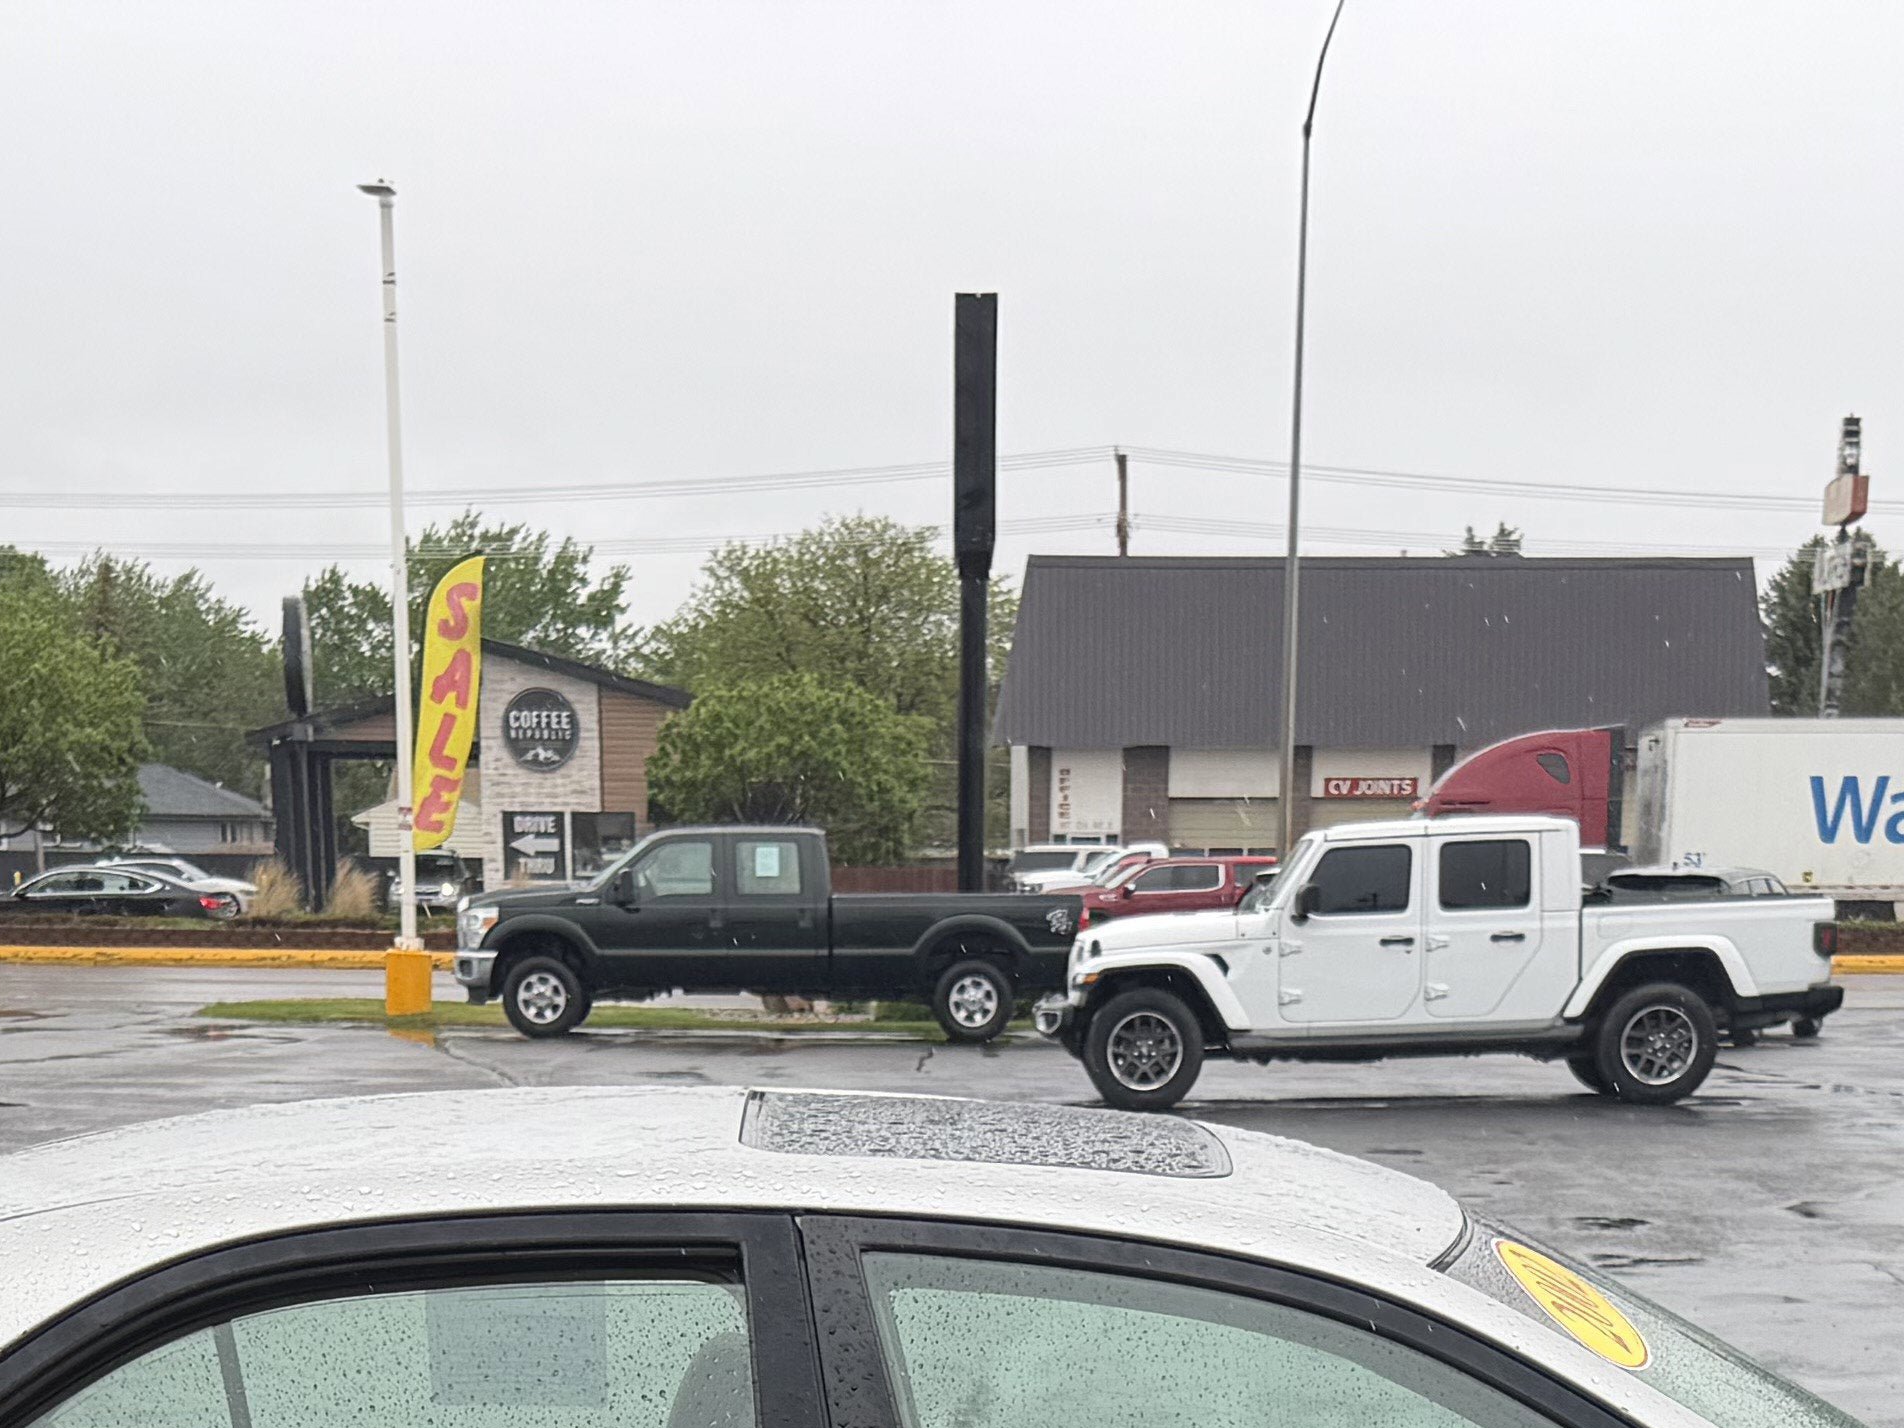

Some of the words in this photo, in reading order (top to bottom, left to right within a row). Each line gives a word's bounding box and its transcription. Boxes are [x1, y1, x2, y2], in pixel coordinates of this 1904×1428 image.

[414, 582, 479, 834] SALE
[508, 710, 572, 730] COFFEE
[1328, 780, 1351, 795] CV
[1353, 780, 1413, 795] JOINTS
